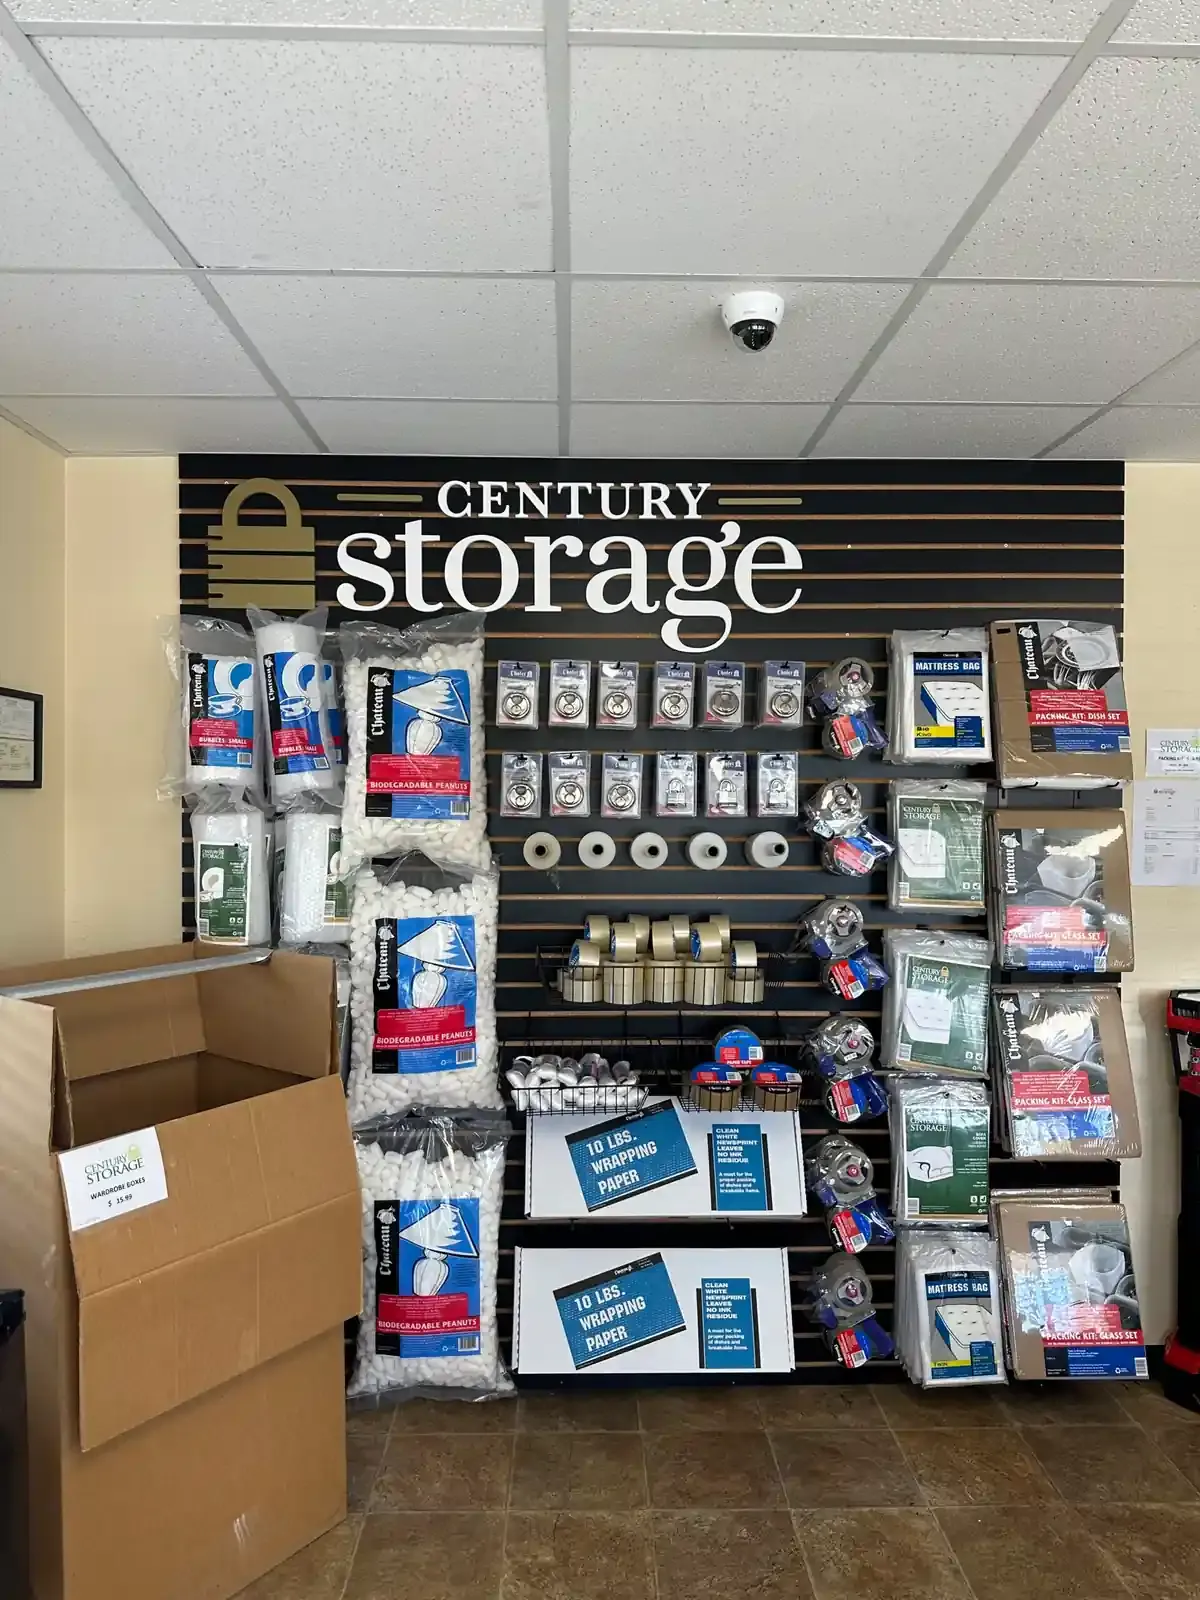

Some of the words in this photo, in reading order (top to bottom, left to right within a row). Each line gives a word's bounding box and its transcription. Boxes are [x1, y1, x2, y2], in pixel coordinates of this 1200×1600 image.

[438, 480, 711, 519] CENTURY
[336, 519, 803, 653] storage
[915, 662, 959, 671] MATTRESS
[963, 662, 980, 671] BAG
[1024, 638, 1039, 680] Chateau
[371, 688, 387, 737] Chateau
[370, 781, 433, 789] BIODEGRADABLE
[1005, 848, 1019, 894] Chateau
[1088, 932, 1101, 940] SET
[377, 941, 392, 991] Chateau
[912, 965, 941, 976] CENTURY
[376, 1034, 440, 1045] BIODEGRADABLE
[441, 1030, 473, 1041] PEANUTS
[1004, 1013, 1021, 1060] Chateau
[1014, 1097, 1050, 1106] PACKING
[1068, 1096, 1092, 1105] GLASS
[1094, 1096, 1106, 1104] SET
[586, 1139, 604, 1157] 10
[607, 1129, 638, 1149] LBS.
[84, 1154, 128, 1175] CENTURY
[86, 1157, 145, 1185] STORAGE
[590, 1141, 659, 1176] WRAPPING
[90, 1182, 126, 1200] WARDROBE
[126, 1176, 146, 1188] BOXES
[597, 1168, 640, 1195] PAPER
[380, 1225, 393, 1276] Chateau
[574, 1295, 593, 1312] 10
[595, 1284, 627, 1305] LBS.
[928, 1283, 969, 1294] MATTRESS
[972, 1283, 988, 1292] BAG
[378, 1320, 442, 1329] BIODEGRADABLE
[442, 1318, 477, 1328] PEANUTS
[579, 1296, 647, 1332] WRAPPING
[586, 1325, 629, 1353] PAPER
[1046, 1332, 1081, 1341] PACKING
[1083, 1331, 1098, 1340] KIT:
[1100, 1331, 1124, 1340] GLASS
[1125, 1331, 1138, 1340] SET
